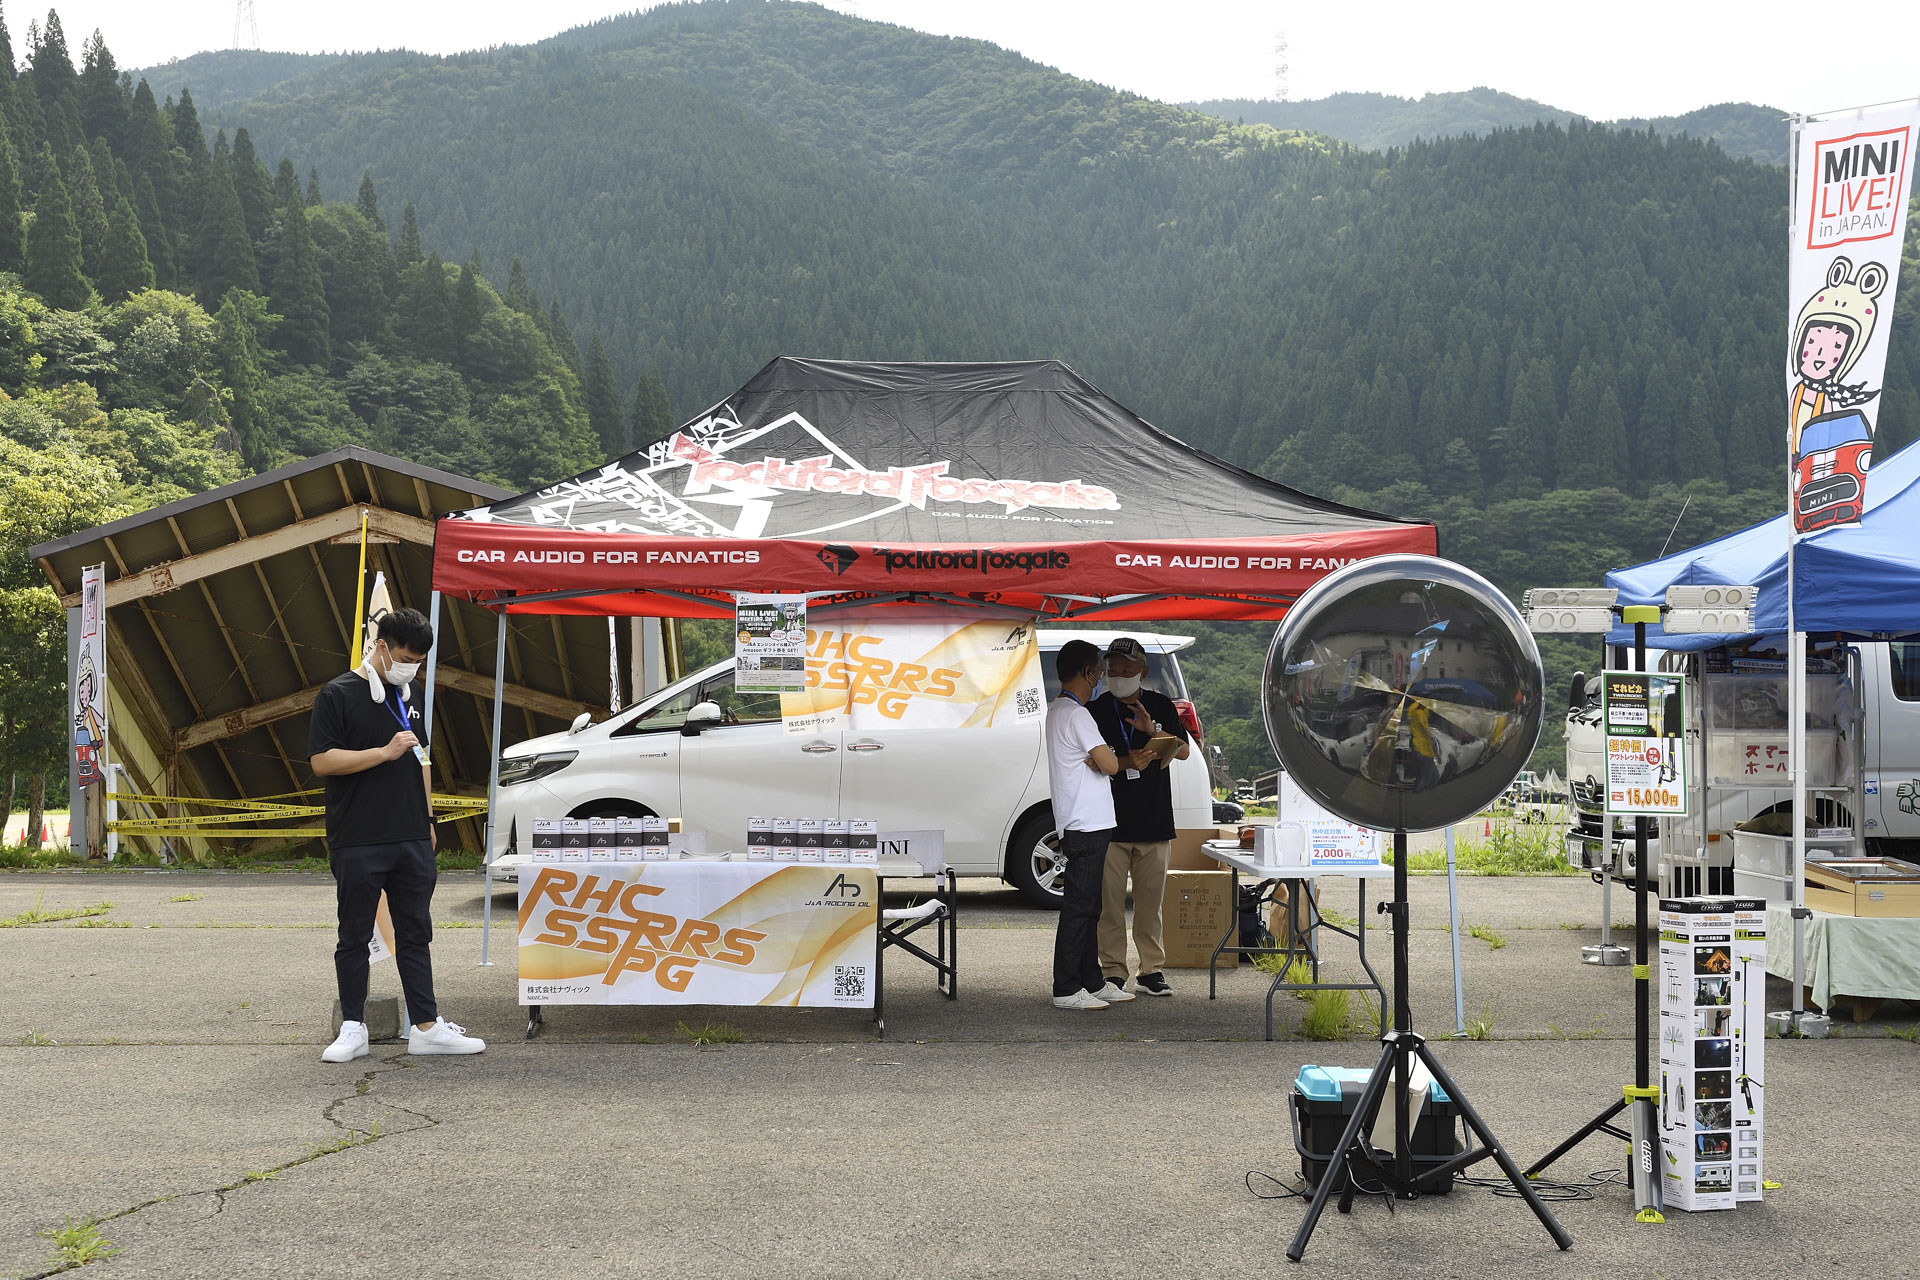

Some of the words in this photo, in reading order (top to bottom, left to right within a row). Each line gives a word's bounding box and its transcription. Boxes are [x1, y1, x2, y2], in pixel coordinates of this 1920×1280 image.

[1824, 140, 1899, 184] MINI
[1821, 176, 1894, 218] LIVE!
[1820, 222, 1832, 238] in
[1836, 212, 1888, 235] JAPAN.
[1810, 493, 1832, 508] MINI
[1044, 517, 1114, 525] FANATICS
[457, 550, 506, 562] CAR
[513, 550, 585, 564] AUDIO
[593, 551, 638, 564] FOR
[646, 550, 760, 564] FANATICS
[1115, 553, 1162, 568] CAR
[1169, 555, 1240, 569] AUDIO
[1247, 556, 1292, 570] FOR
[1299, 558, 1363, 570] FANA
[788, 716, 836, 727] 株式会社ナヴィック
[1626, 788, 1679, 808] 15,000円
[877, 840, 910, 855] INI
[519, 868, 666, 935] RHC
[602, 942, 702, 993] PG
[527, 986, 590, 994] 株式会社ナヴィック
